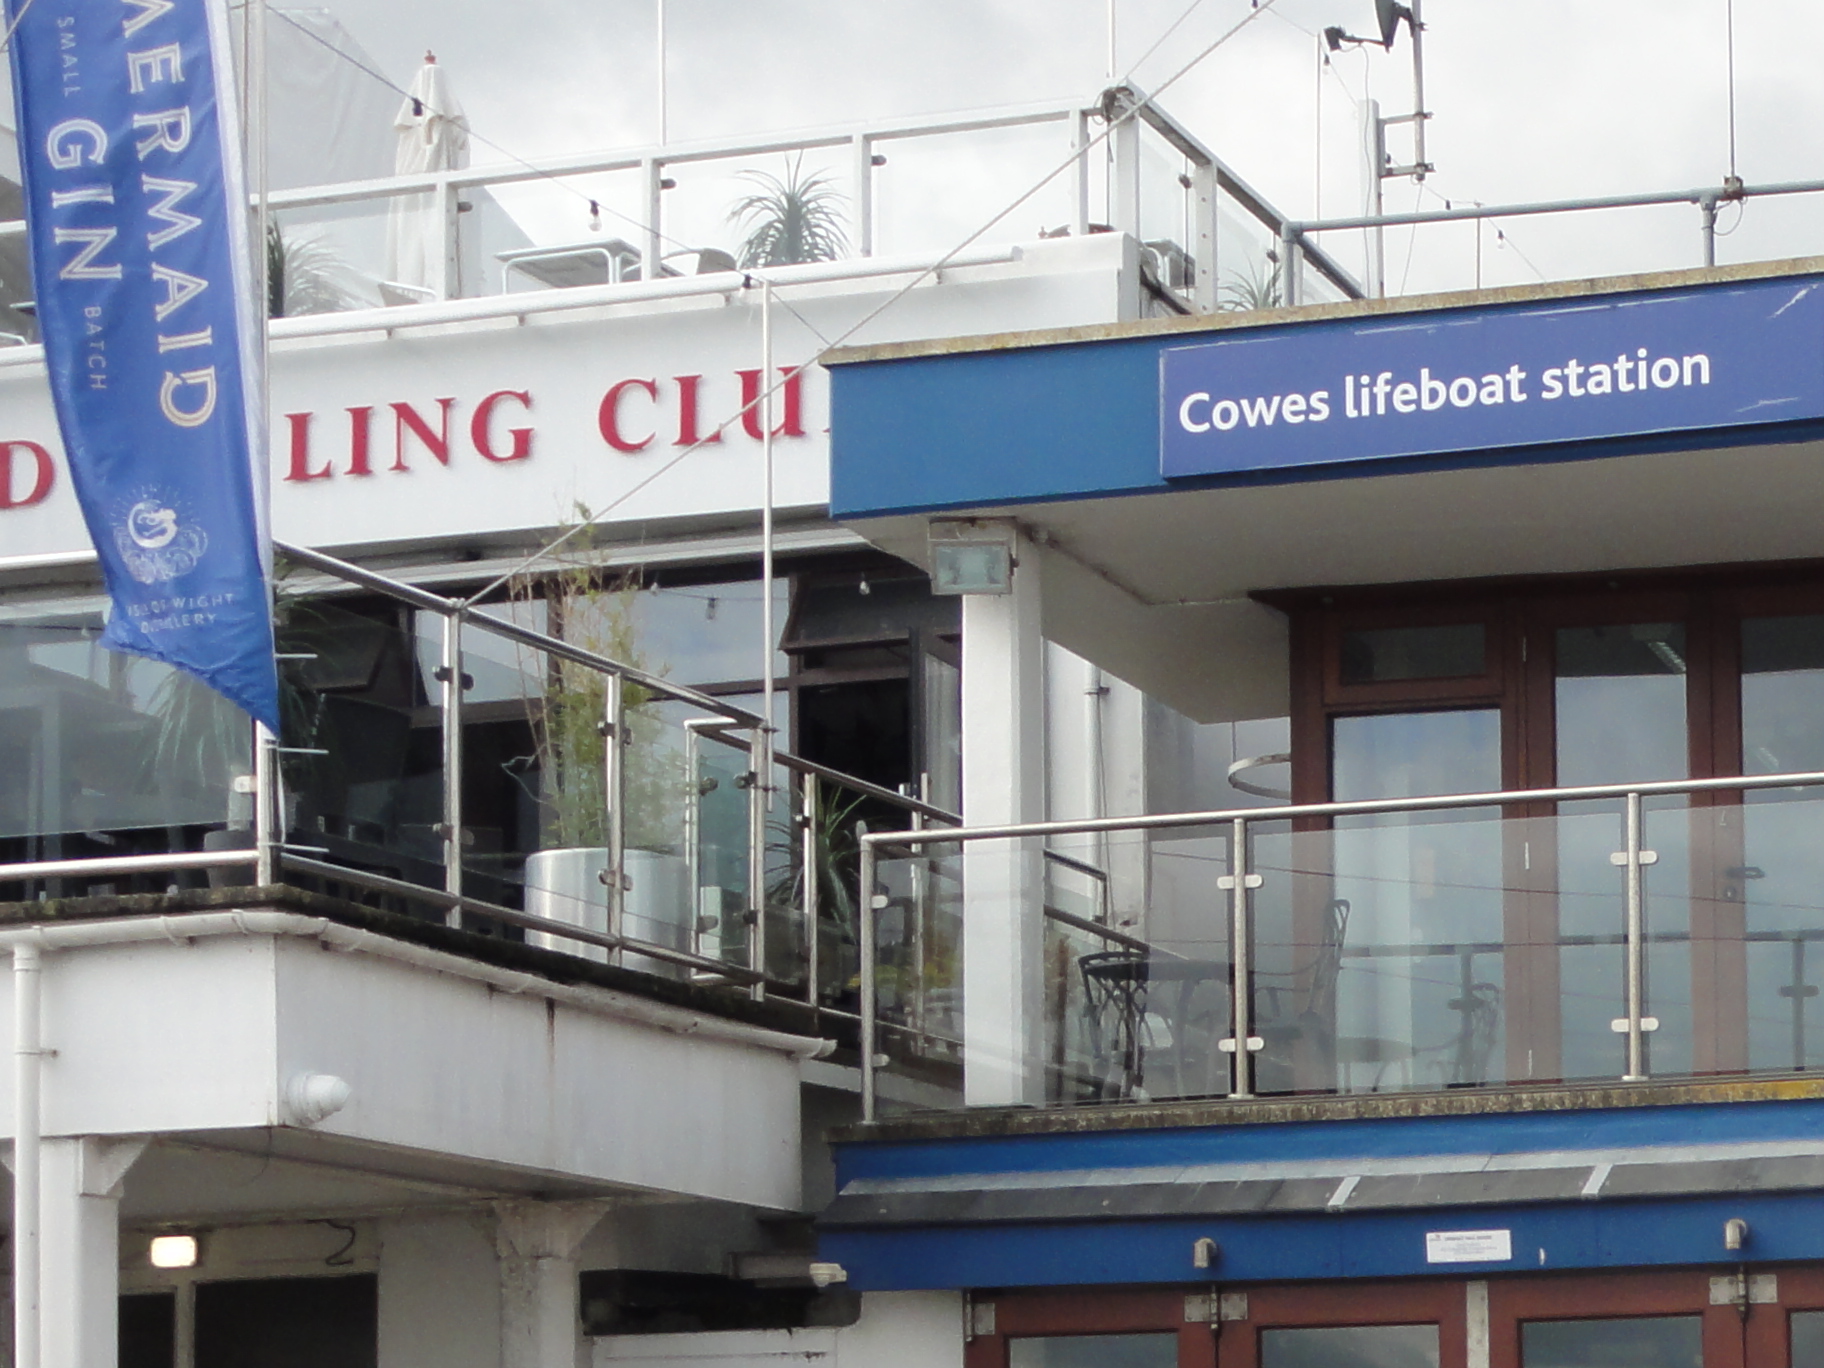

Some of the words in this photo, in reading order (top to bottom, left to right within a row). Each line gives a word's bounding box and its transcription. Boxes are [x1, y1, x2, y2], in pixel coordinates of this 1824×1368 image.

[57, 16, 81, 97] SMALL
[47, 118, 123, 281] GIN
[84, 306, 107, 389] BATCH
[598, 365, 830, 453] CLU
[1179, 389, 1330, 434] Cowes
[1344, 363, 1528, 419] lifeboat
[1541, 348, 1711, 400] station
[172, 593, 234, 610] WIGHT
